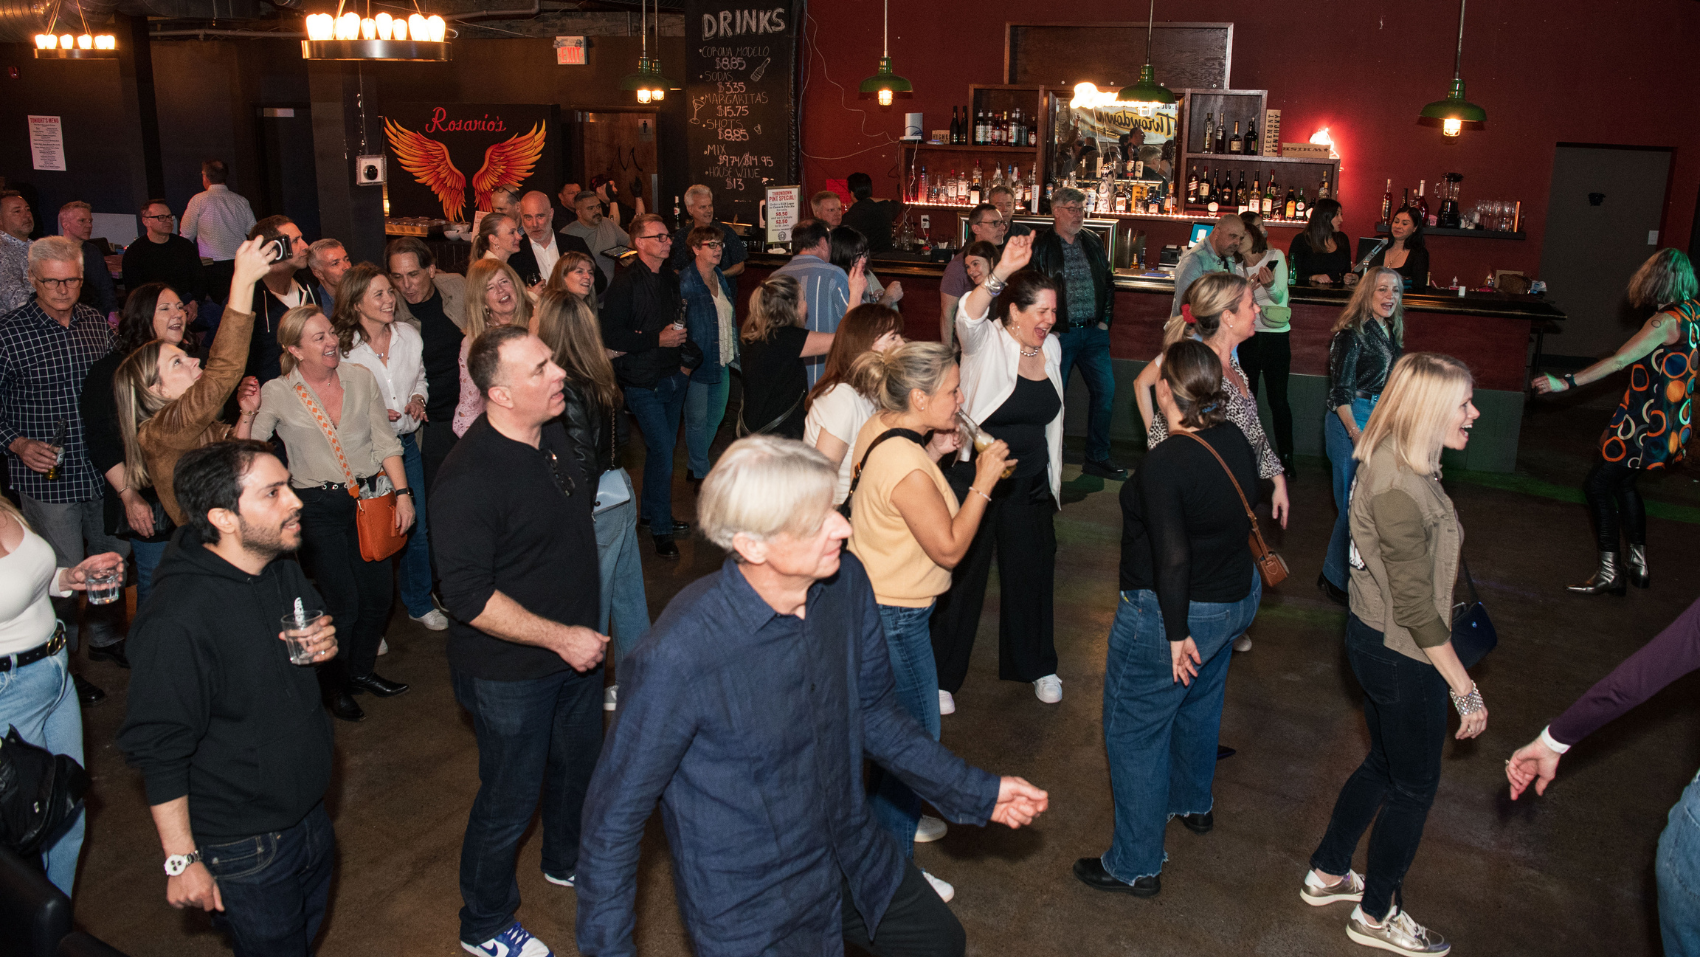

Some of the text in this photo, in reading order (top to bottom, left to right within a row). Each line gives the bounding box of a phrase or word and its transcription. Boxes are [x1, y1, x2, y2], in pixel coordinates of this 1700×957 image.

[702, 8, 785, 41] DRINKS
[560, 46, 581, 63] EXIT
[735, 46, 769, 57] MODELO
[715, 57, 746, 70] $8.85
[705, 71, 733, 82] SODAS
[704, 92, 768, 104] MARGARITAS
[716, 105, 749, 117] $15.75
[425, 107, 506, 133] Rosario's
[707, 119, 743, 130] SHOTS
[718, 127, 749, 141] $8.85
[1265, 114, 1274, 153] CLERMONT
[1271, 114, 1281, 153] KENTUCKY
[707, 144, 726, 156] MIX
[708, 166, 760, 178] HOUSE WINE
[725, 177, 745, 191] $13
